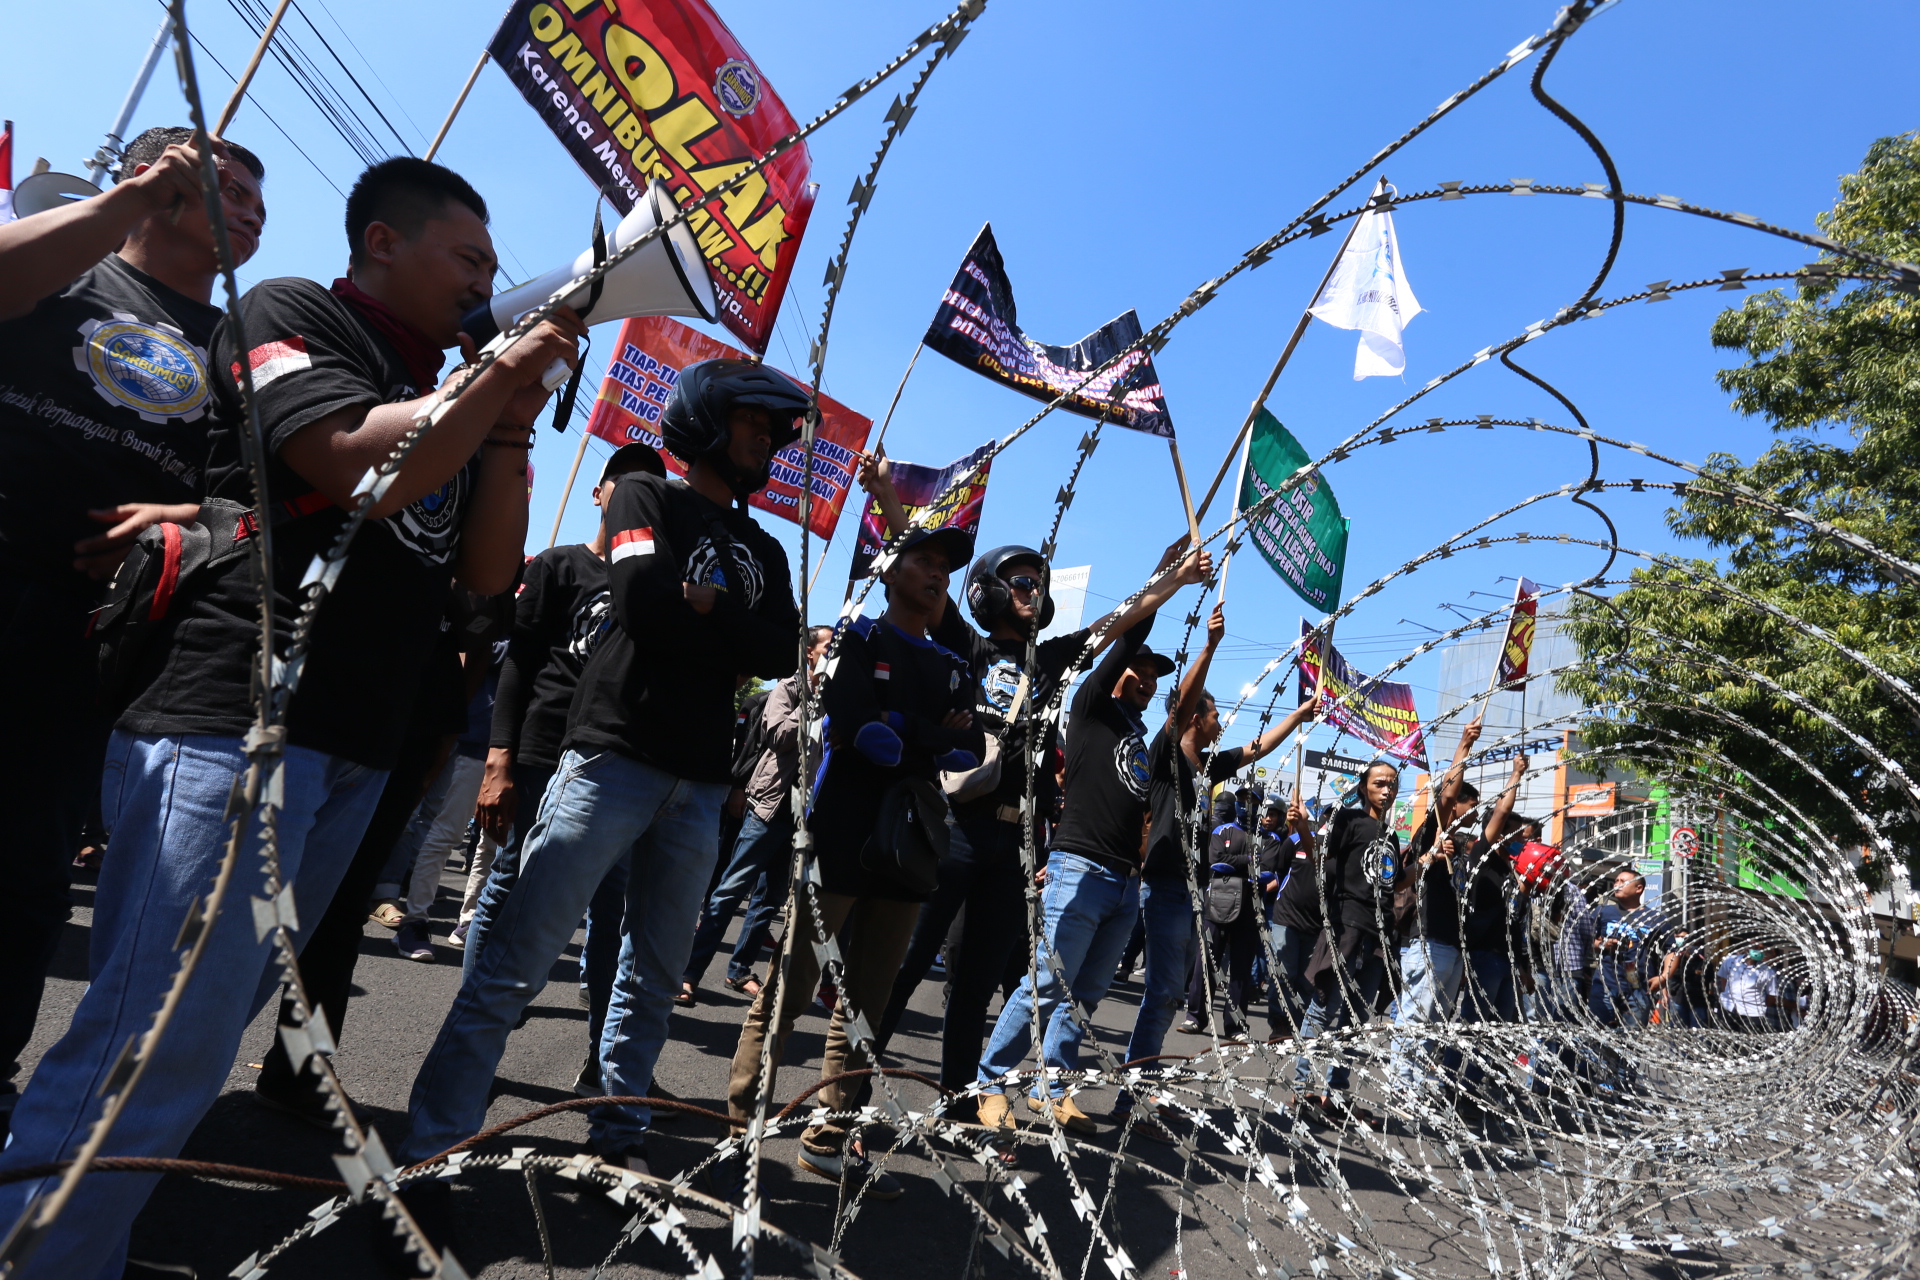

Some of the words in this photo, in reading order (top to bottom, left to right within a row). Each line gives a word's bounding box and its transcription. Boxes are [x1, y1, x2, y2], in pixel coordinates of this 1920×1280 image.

[517, 42, 594, 141] Karena
[530, 3, 673, 189] OMNIBUS
[724, 71, 753, 106] SARBUMUSI
[941, 288, 990, 326] DENGAN
[110, 342, 194, 393] SARBUMUSI
[605, 360, 646, 392] ATAS
[1013, 373, 1044, 389] 1945
[619, 388, 660, 422] YANG
[37, 398, 119, 442] Perjuangan
[121, 430, 165, 461] Buruh
[766, 490, 798, 507] ayat
[1290, 487, 1315, 524] USIR
[1262, 512, 1285, 541] INA
[1281, 530, 1310, 575] ILEGAL
[1271, 496, 1300, 531] KERJA
[1295, 524, 1317, 555] ASING
[1313, 548, 1337, 578] (TKA)
[1304, 687, 1333, 704] Buan
[1362, 709, 1409, 736] SENDIRI
